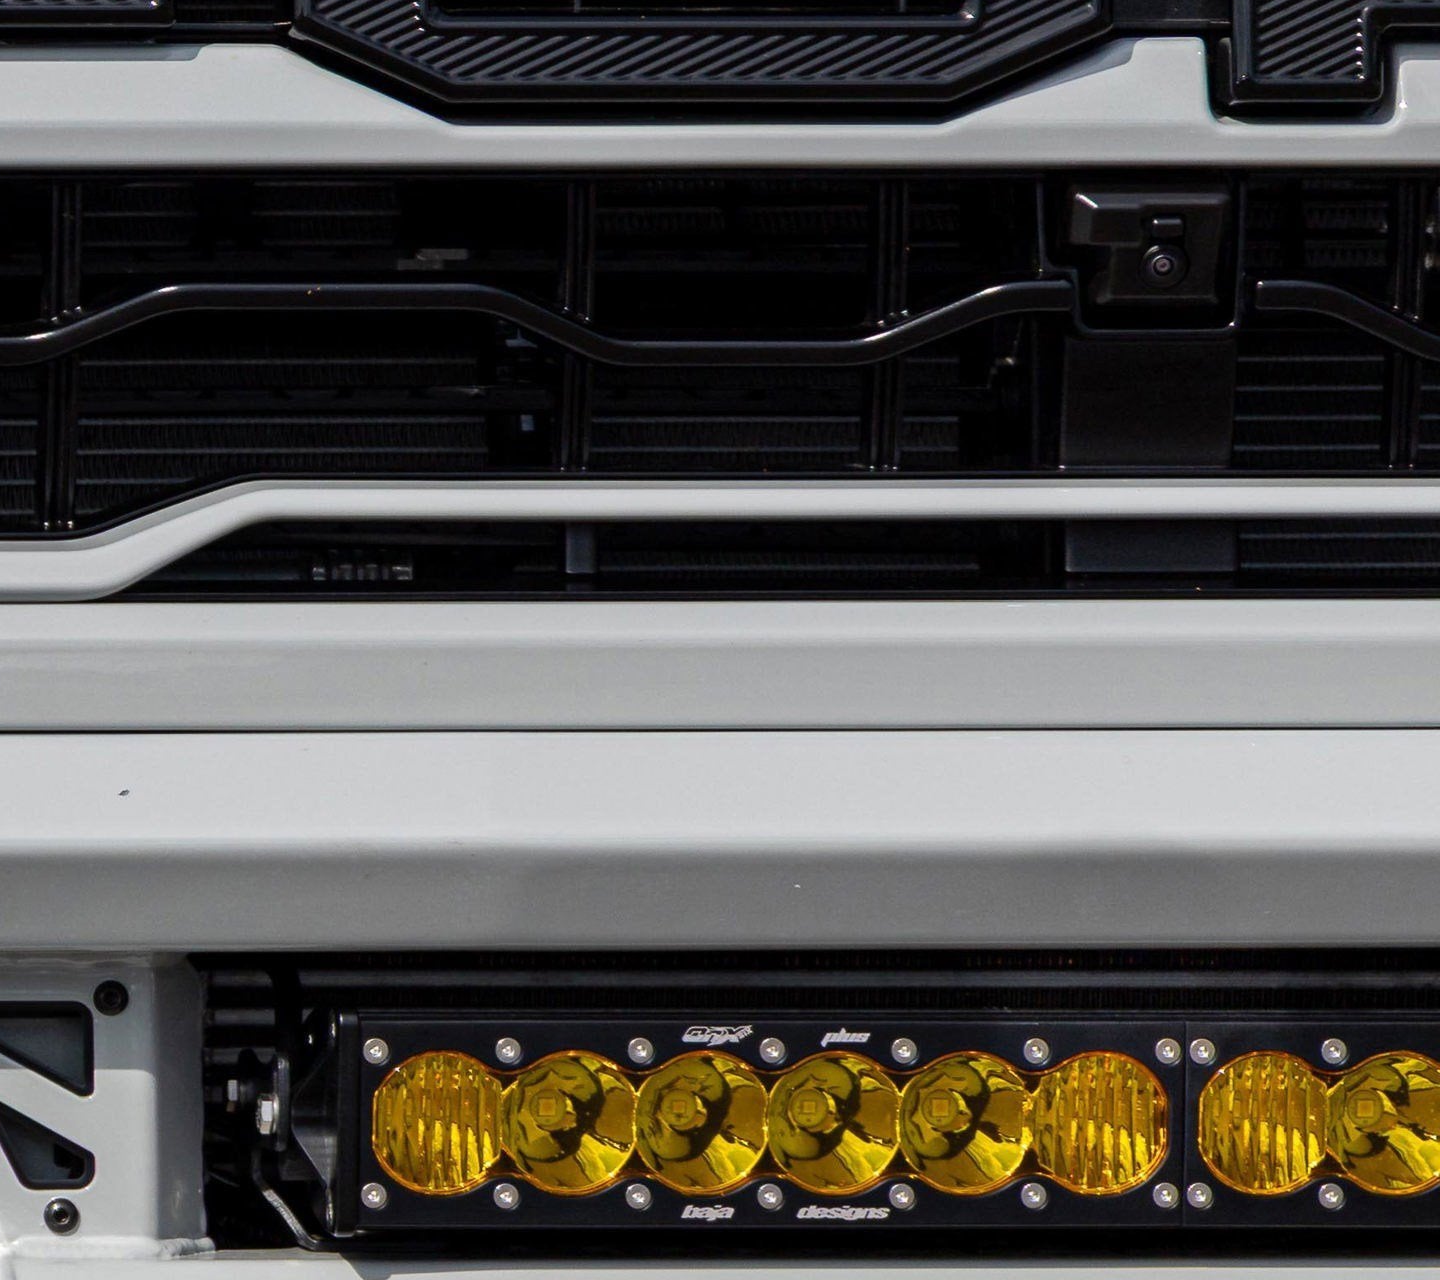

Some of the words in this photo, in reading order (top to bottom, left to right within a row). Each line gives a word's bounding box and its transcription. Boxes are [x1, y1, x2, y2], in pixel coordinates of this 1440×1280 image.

[820, 1028, 871, 1047] plus
[681, 1205, 734, 1221] baja
[796, 1205, 890, 1221] designs
